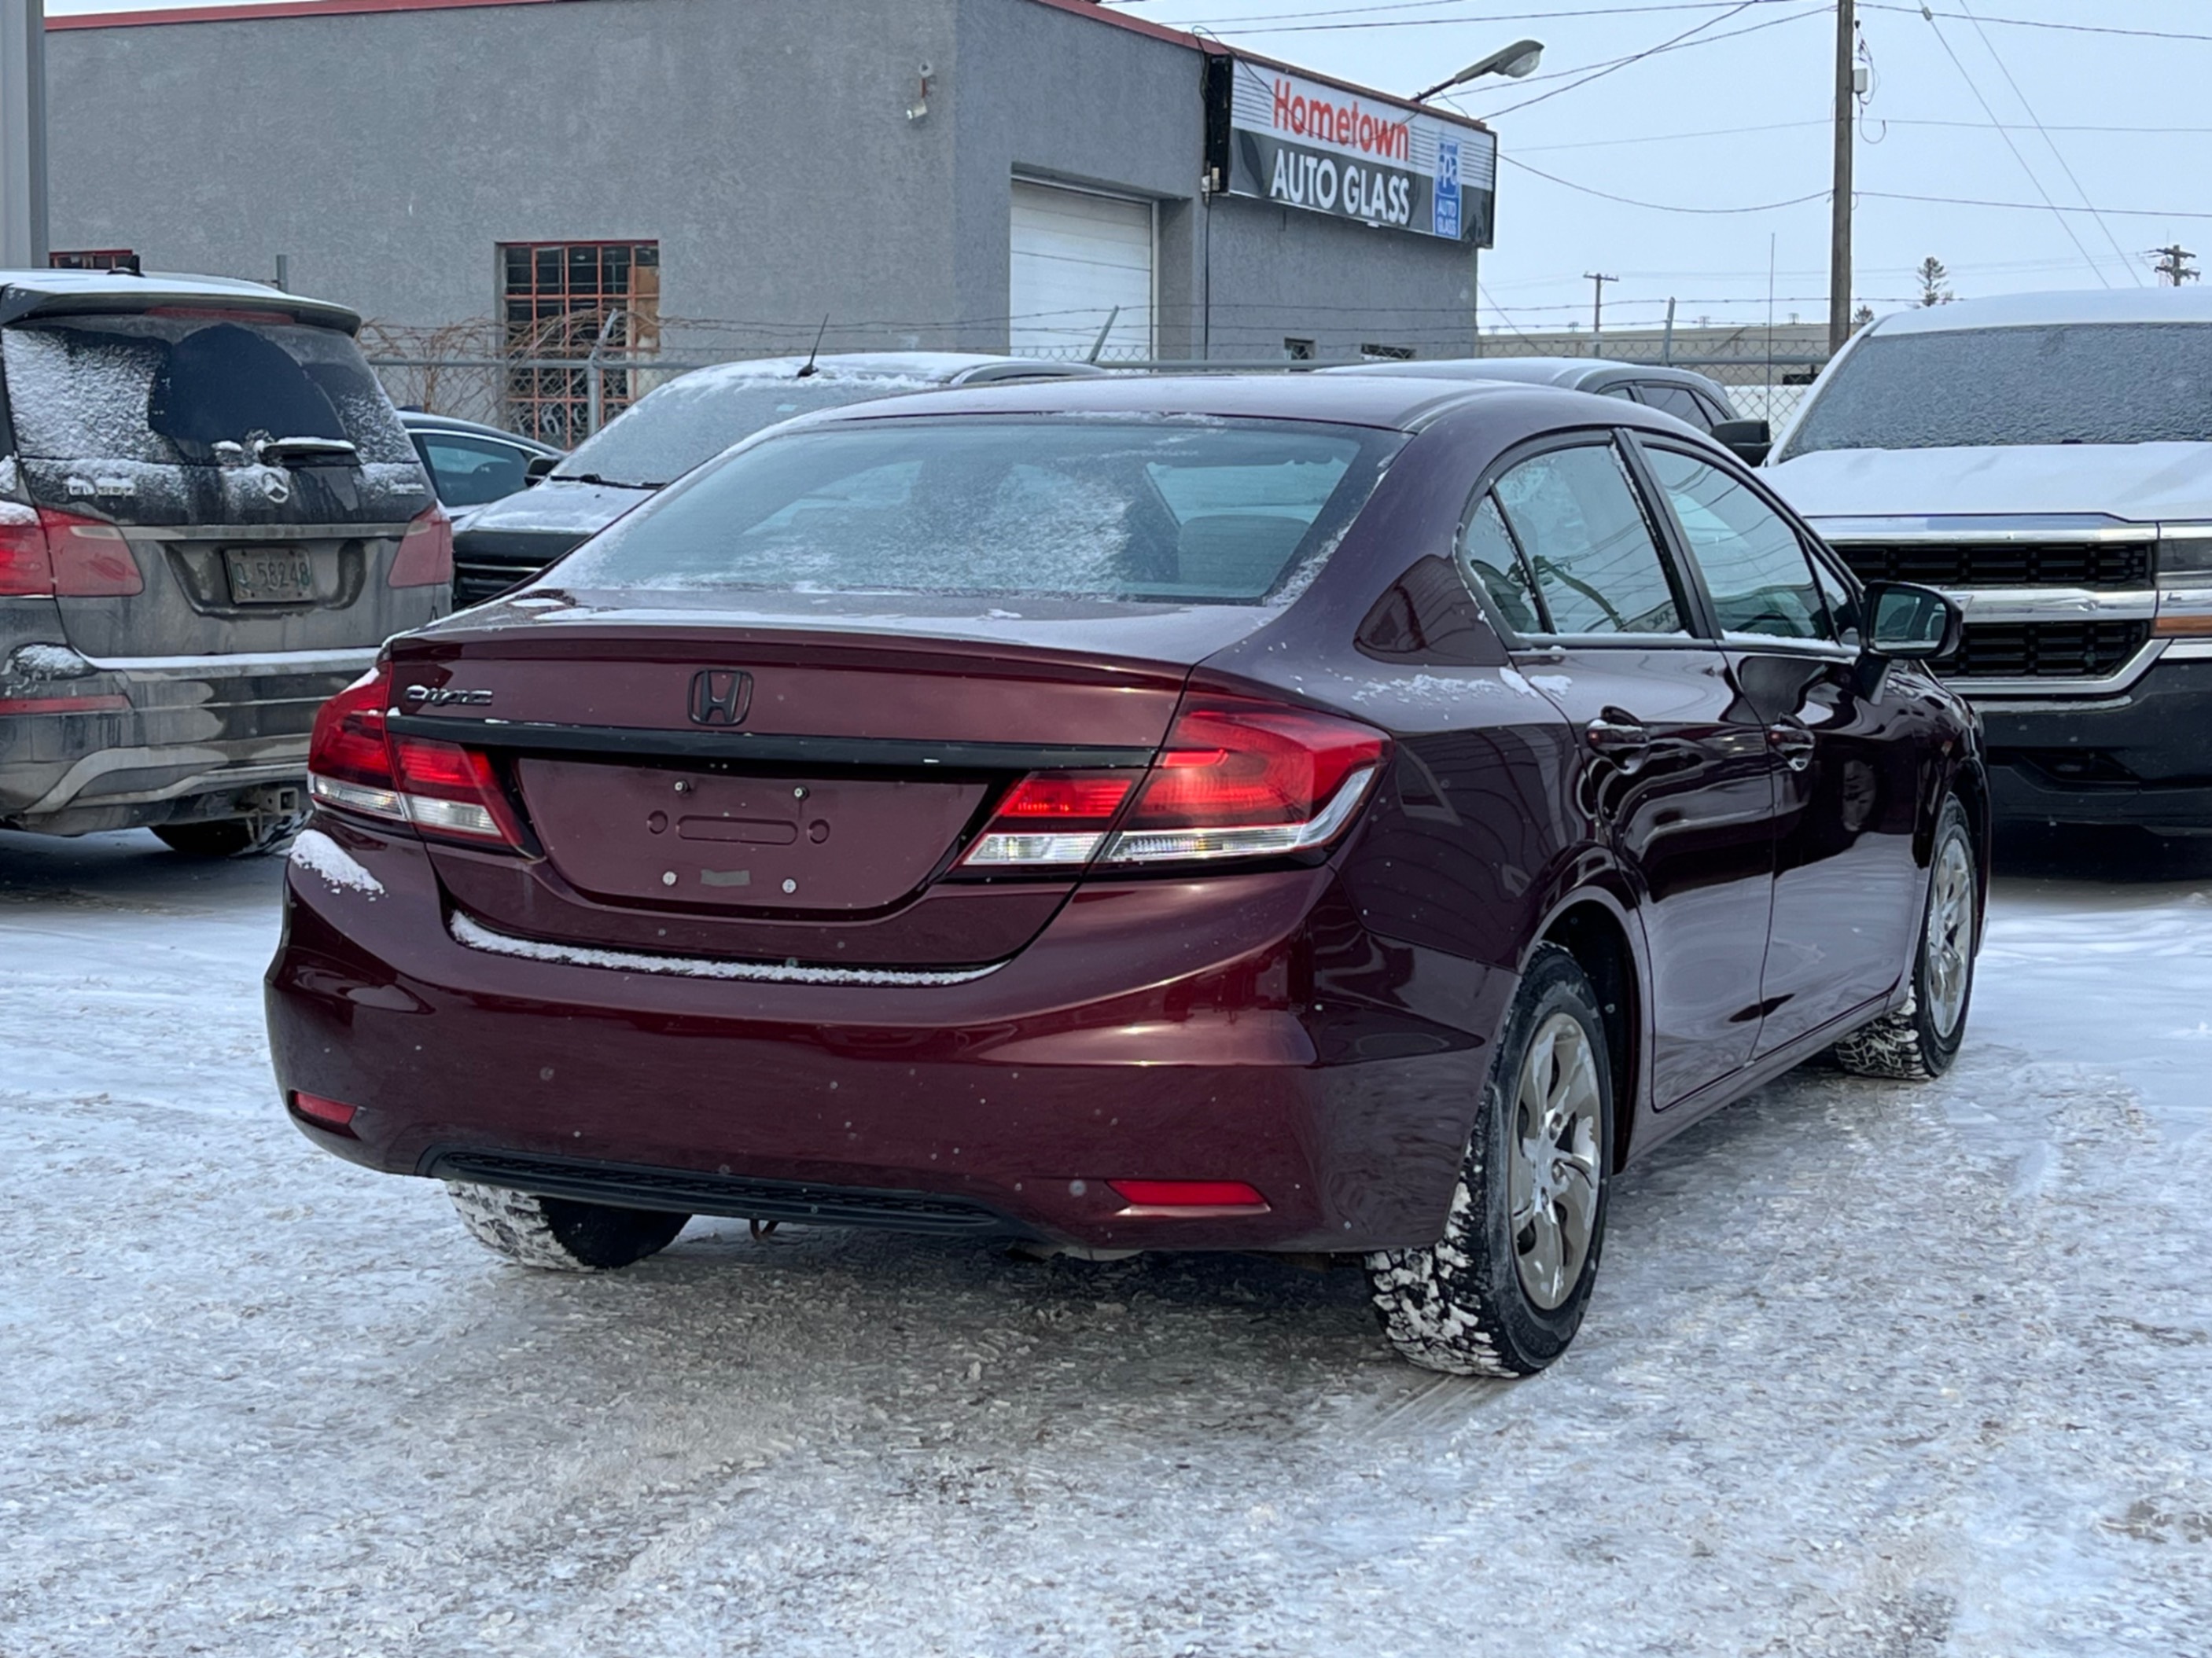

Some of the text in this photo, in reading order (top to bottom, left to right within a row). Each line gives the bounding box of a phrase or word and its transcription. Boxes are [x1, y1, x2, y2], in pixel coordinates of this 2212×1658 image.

[1273, 79, 1408, 161] Hometown
[1272, 149, 1410, 225] AUTO GLASS
